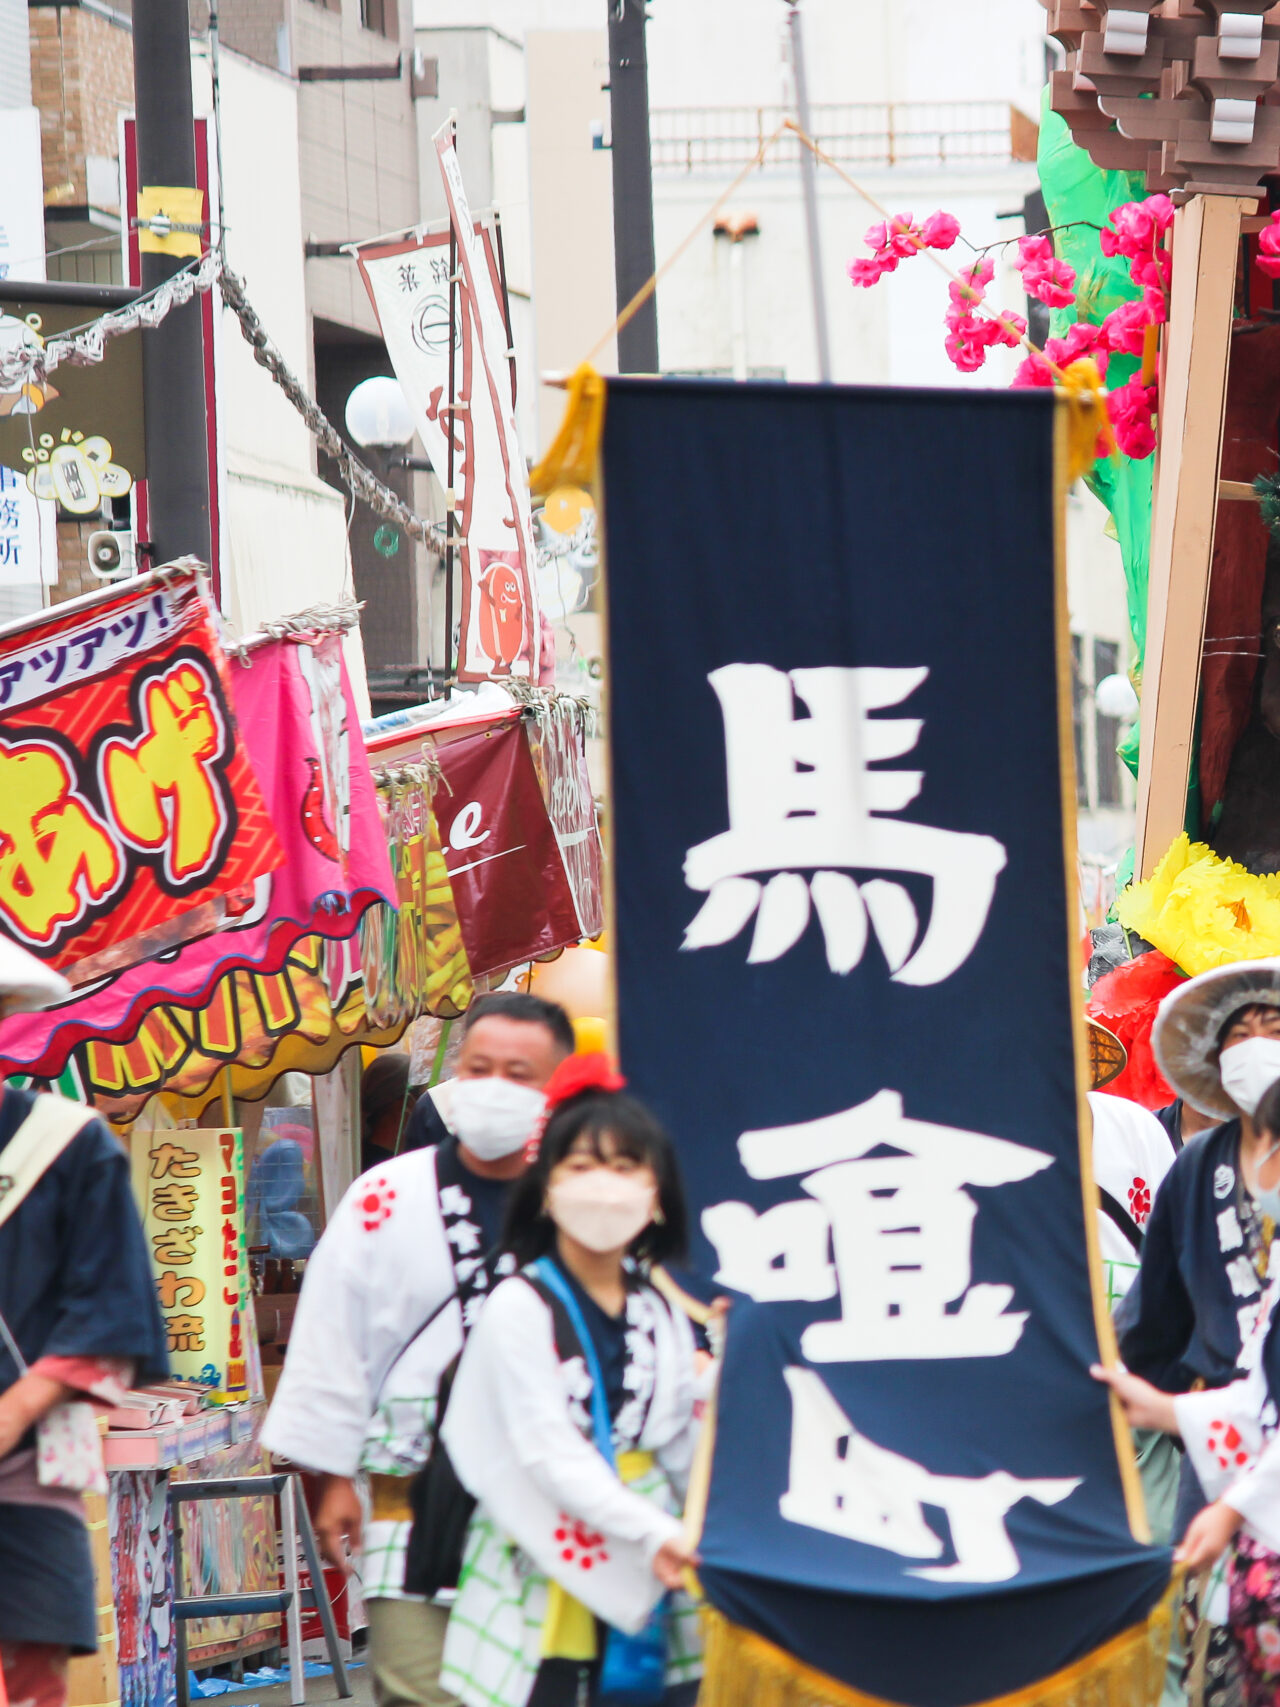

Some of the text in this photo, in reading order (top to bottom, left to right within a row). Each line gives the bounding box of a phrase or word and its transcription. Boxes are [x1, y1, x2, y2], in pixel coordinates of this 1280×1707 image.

[149, 1142, 206, 1352] たきざわ流
